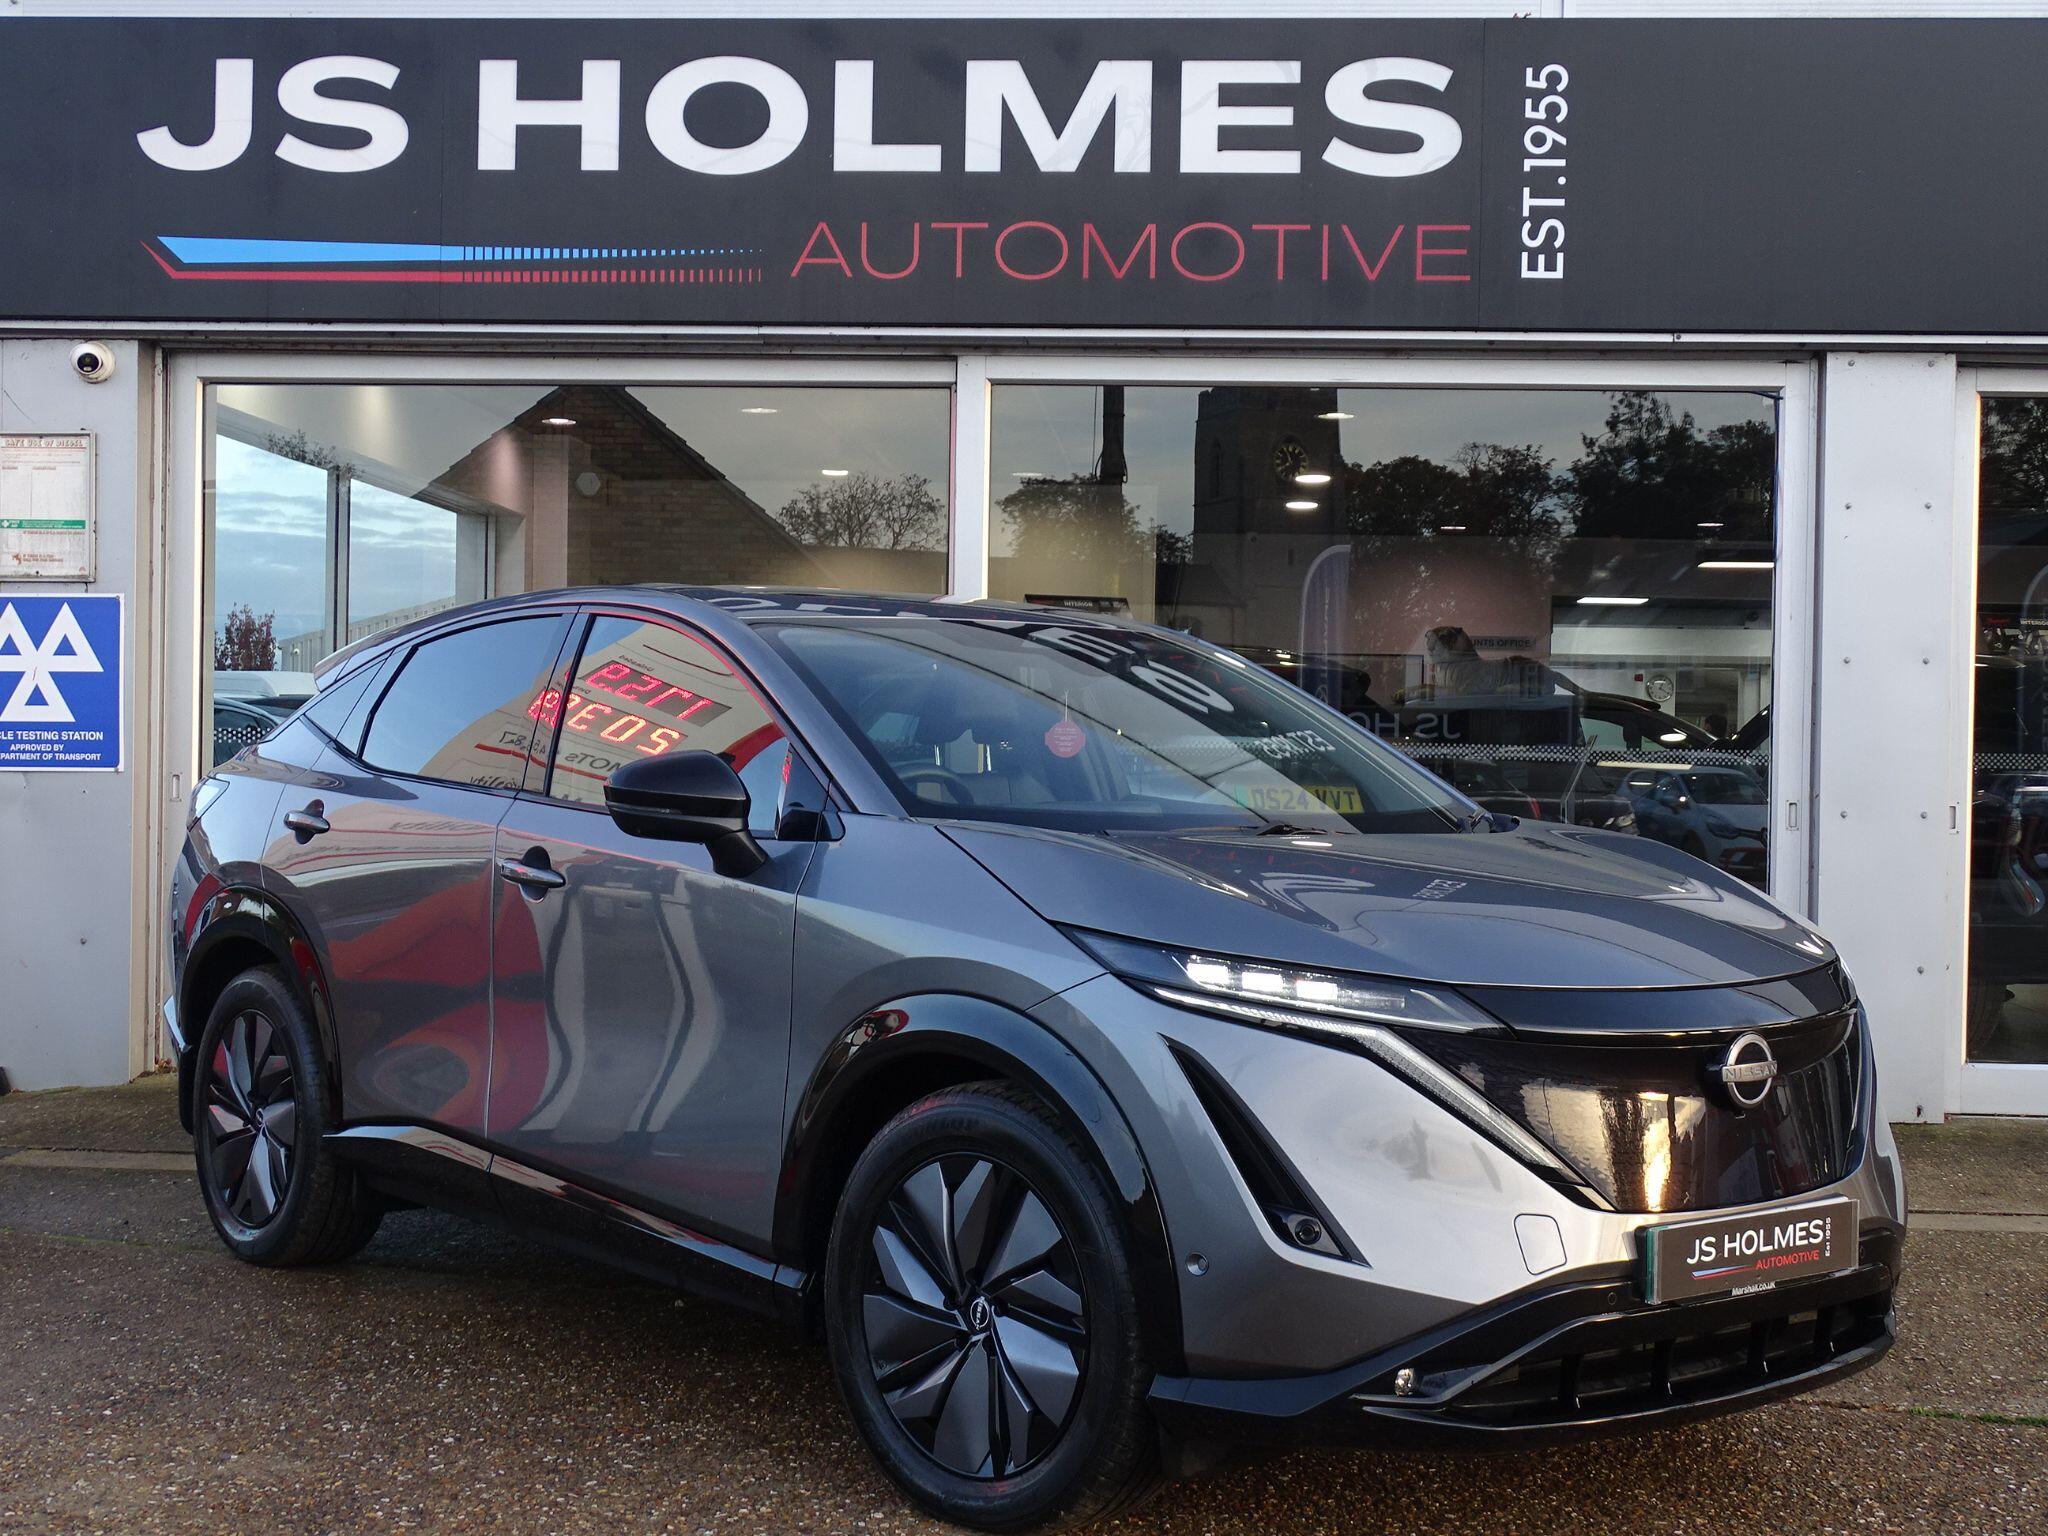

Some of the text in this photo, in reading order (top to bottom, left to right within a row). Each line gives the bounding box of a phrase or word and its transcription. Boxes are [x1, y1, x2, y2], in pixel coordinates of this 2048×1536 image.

[136, 55, 1463, 177] JS HOLMES
[1521, 62, 1569, 280] EST.1955
[790, 220, 1471, 282] AUTOMOTIVE
[1497, 638, 1532, 648] OFFICE
[16, 731, 59, 740] TESTING
[61, 731, 104, 740] STATION
[0, 752, 102, 761] PARTMENT OF TRANSPORT
[10, 743, 65, 752] APPROVED BY
[1724, 1063, 1777, 1080] NISSAN
[1686, 1219, 1824, 1265] JS HOLMES
[1755, 1249, 1820, 1271] AUTOMOTIVE
